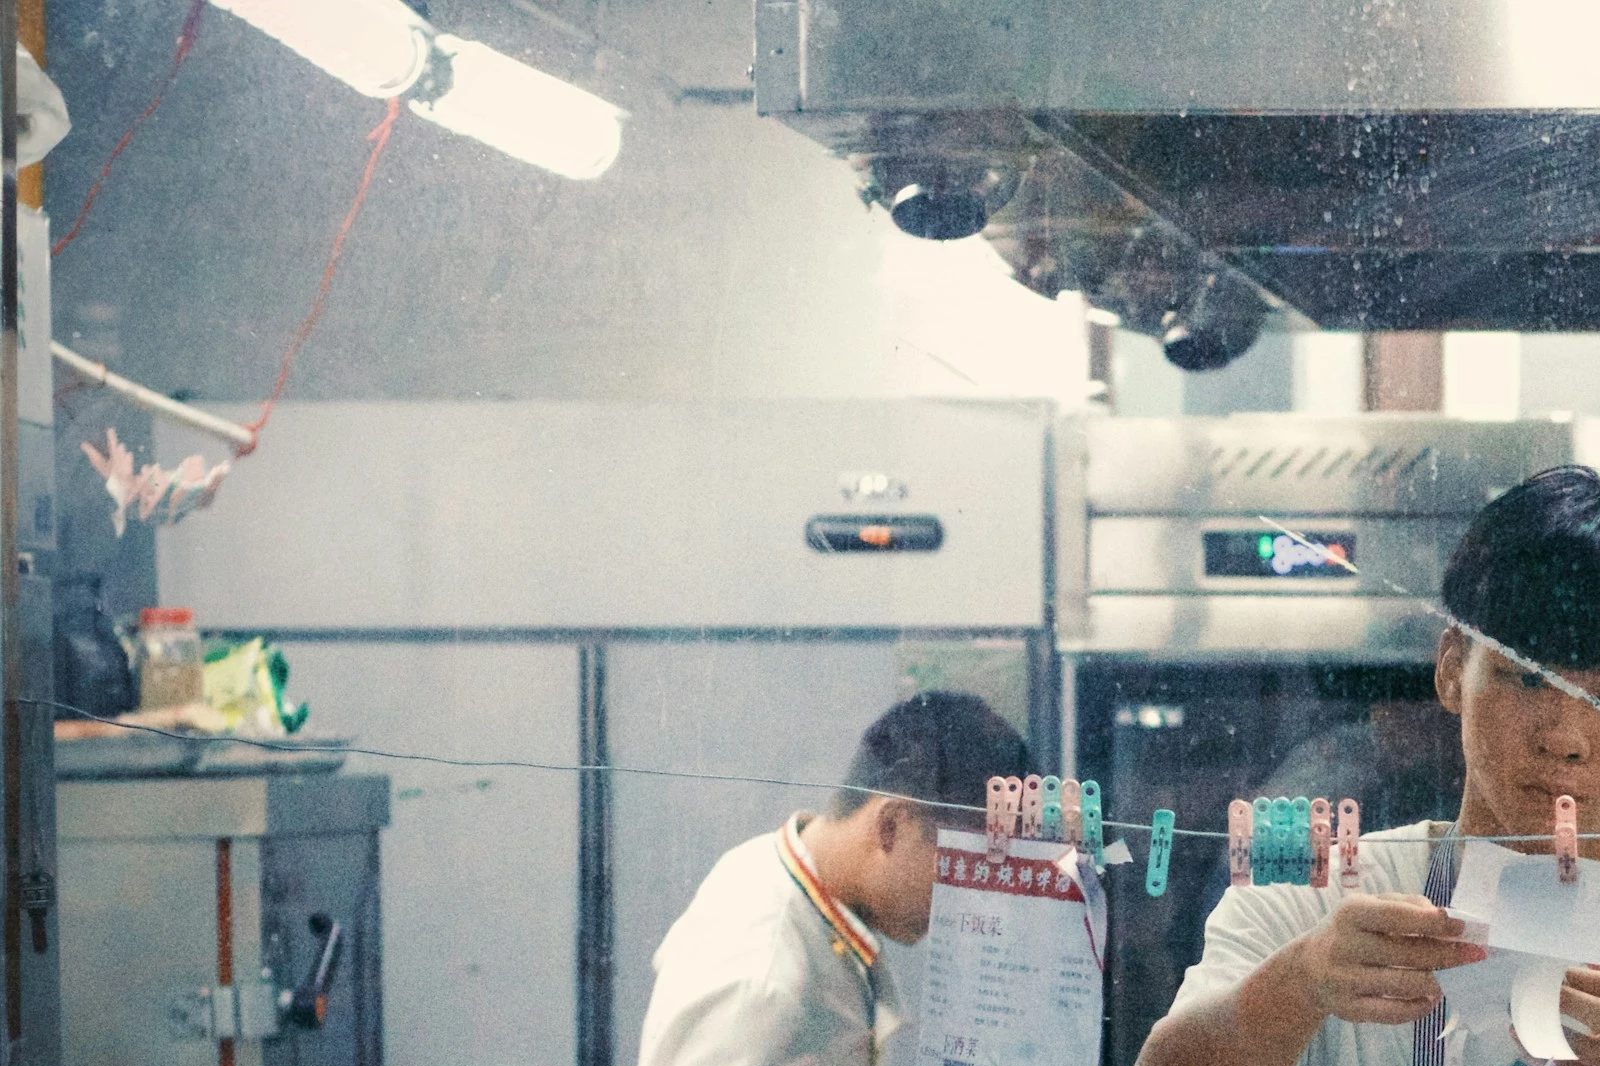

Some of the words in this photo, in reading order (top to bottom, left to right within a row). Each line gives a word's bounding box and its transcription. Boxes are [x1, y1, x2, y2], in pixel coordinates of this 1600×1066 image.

[957, 912, 1003, 936] 下饭菜
[943, 1034, 980, 1058] 下酒菜
